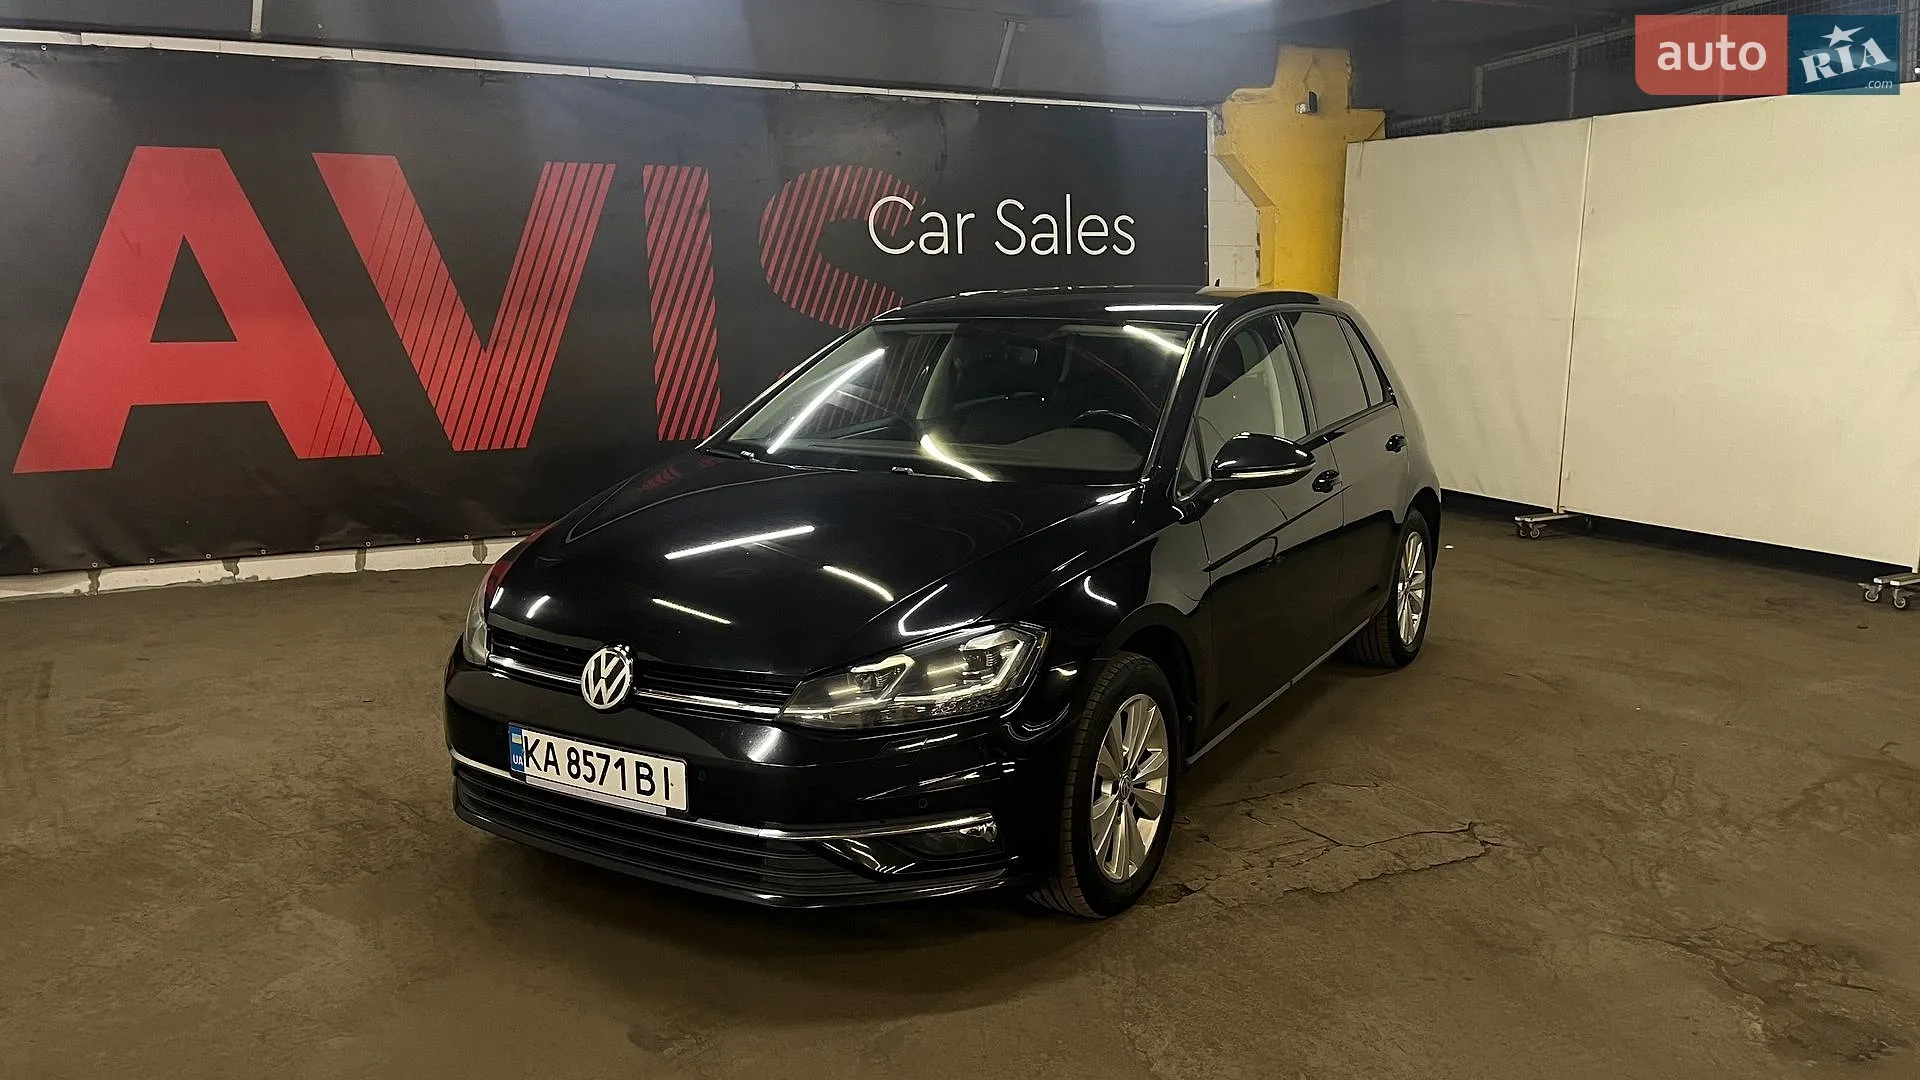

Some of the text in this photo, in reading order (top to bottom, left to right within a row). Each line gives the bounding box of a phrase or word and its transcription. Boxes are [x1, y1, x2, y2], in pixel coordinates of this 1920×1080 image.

[868, 193, 1136, 256] Car Sales
[13, 146, 927, 474] AVIS
[512, 754, 524, 766] UA
[523, 735, 670, 801] KA 8571 BI
